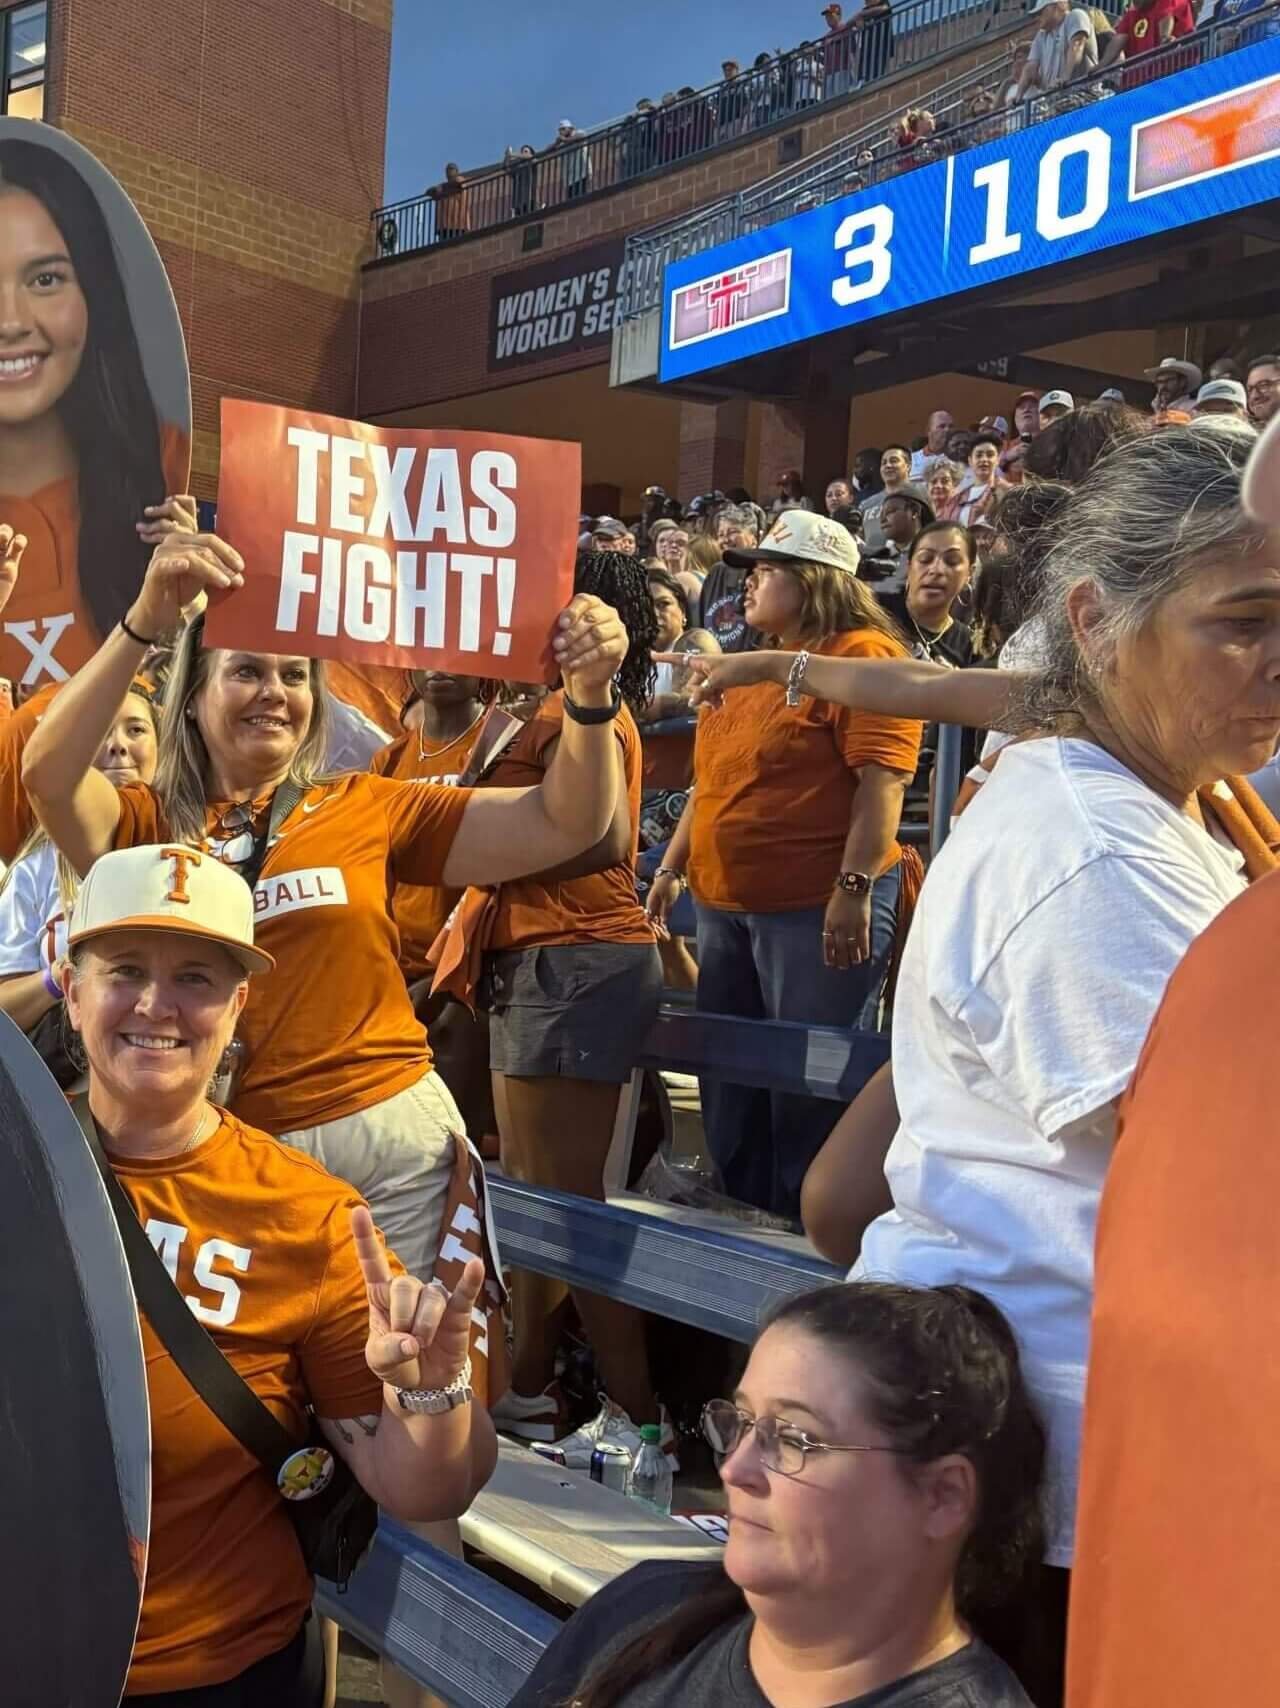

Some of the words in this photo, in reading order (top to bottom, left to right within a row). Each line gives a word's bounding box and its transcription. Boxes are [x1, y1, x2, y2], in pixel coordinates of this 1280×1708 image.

[831, 204, 894, 306] 3
[968, 126, 1111, 266] 10
[496, 310, 577, 360] WORLD
[497, 267, 611, 328] WOMEN'S
[287, 426, 517, 549] TEXAS
[275, 530, 517, 657] FIGHT!
[160, 848, 202, 904] T
